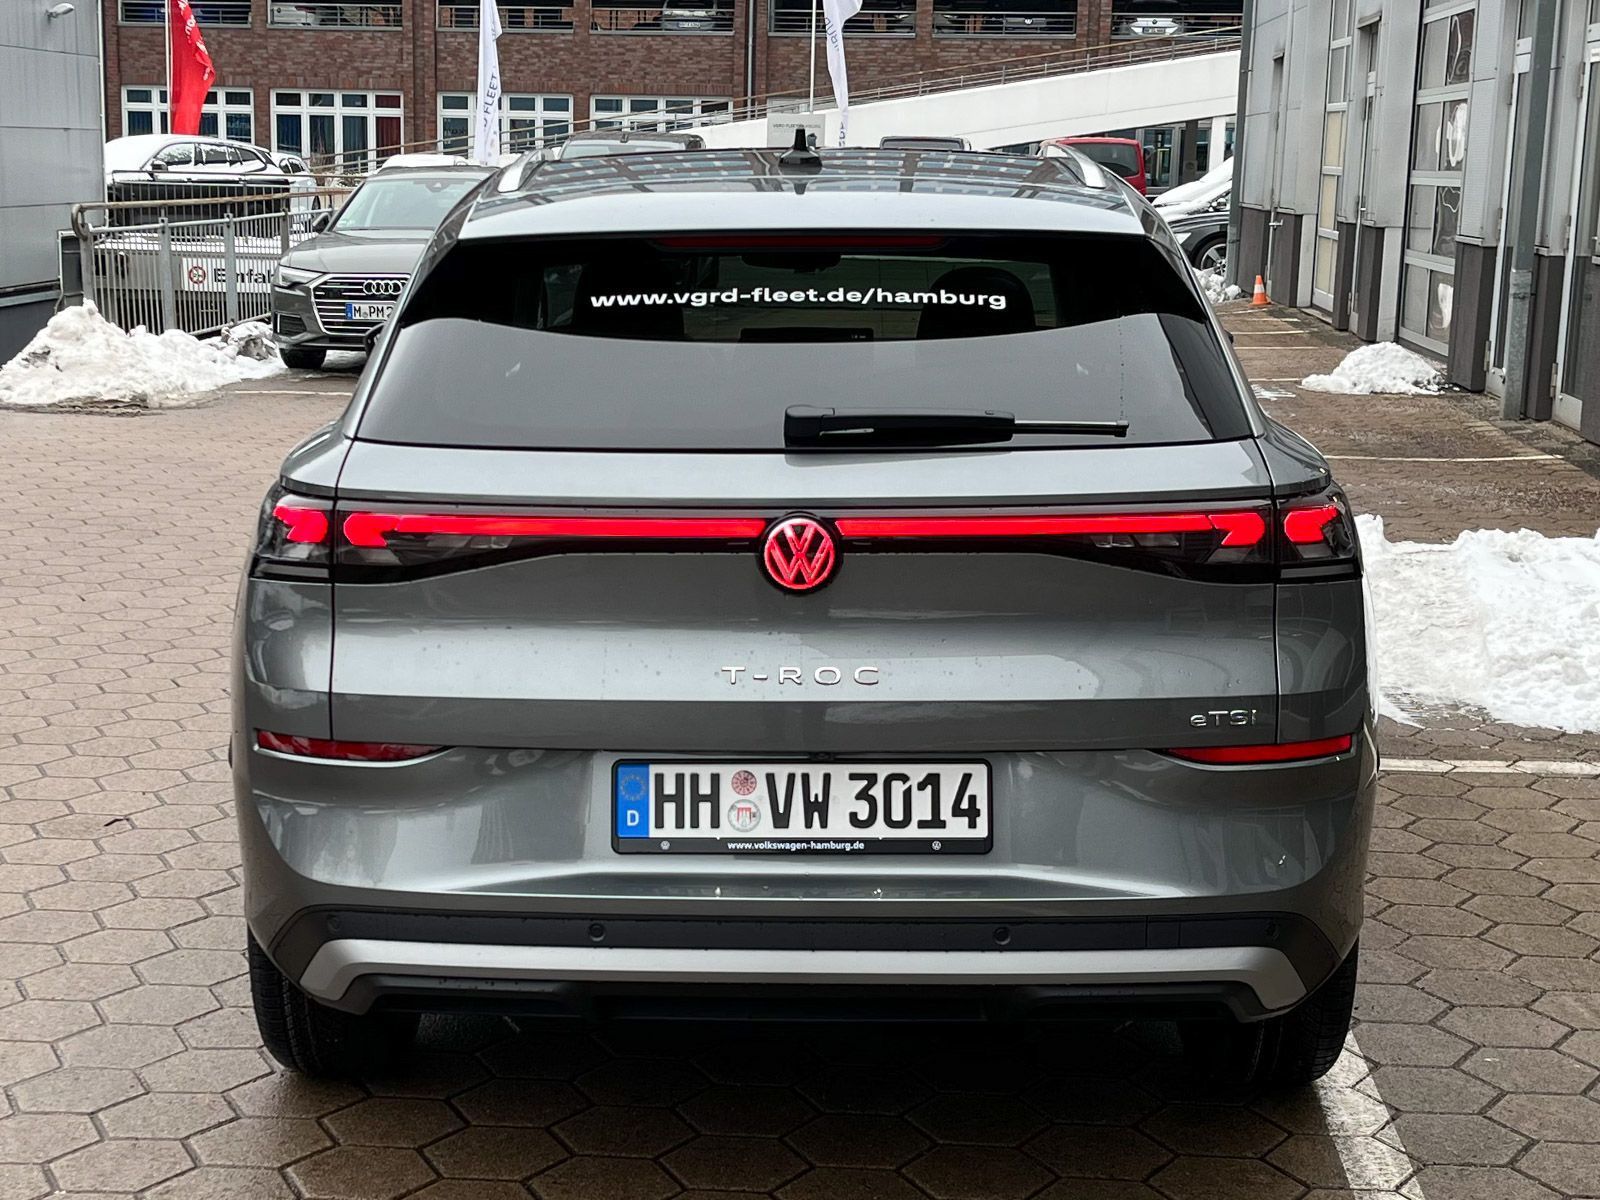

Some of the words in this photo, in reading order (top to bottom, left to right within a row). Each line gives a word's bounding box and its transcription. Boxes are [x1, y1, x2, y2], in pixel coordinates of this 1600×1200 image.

[484, 75, 498, 115] FLEET
[590, 286, 1007, 310] www.vgrd-fleet.de/hamburg
[353, 305, 362, 318] M
[721, 665, 879, 685] T-ROC
[654, 772, 721, 829] HH
[765, 772, 832, 829] VW
[848, 772, 982, 829] 3014
[626, 810, 640, 826] D
[727, 840, 865, 851] www.volkswagen-hamburg.de
